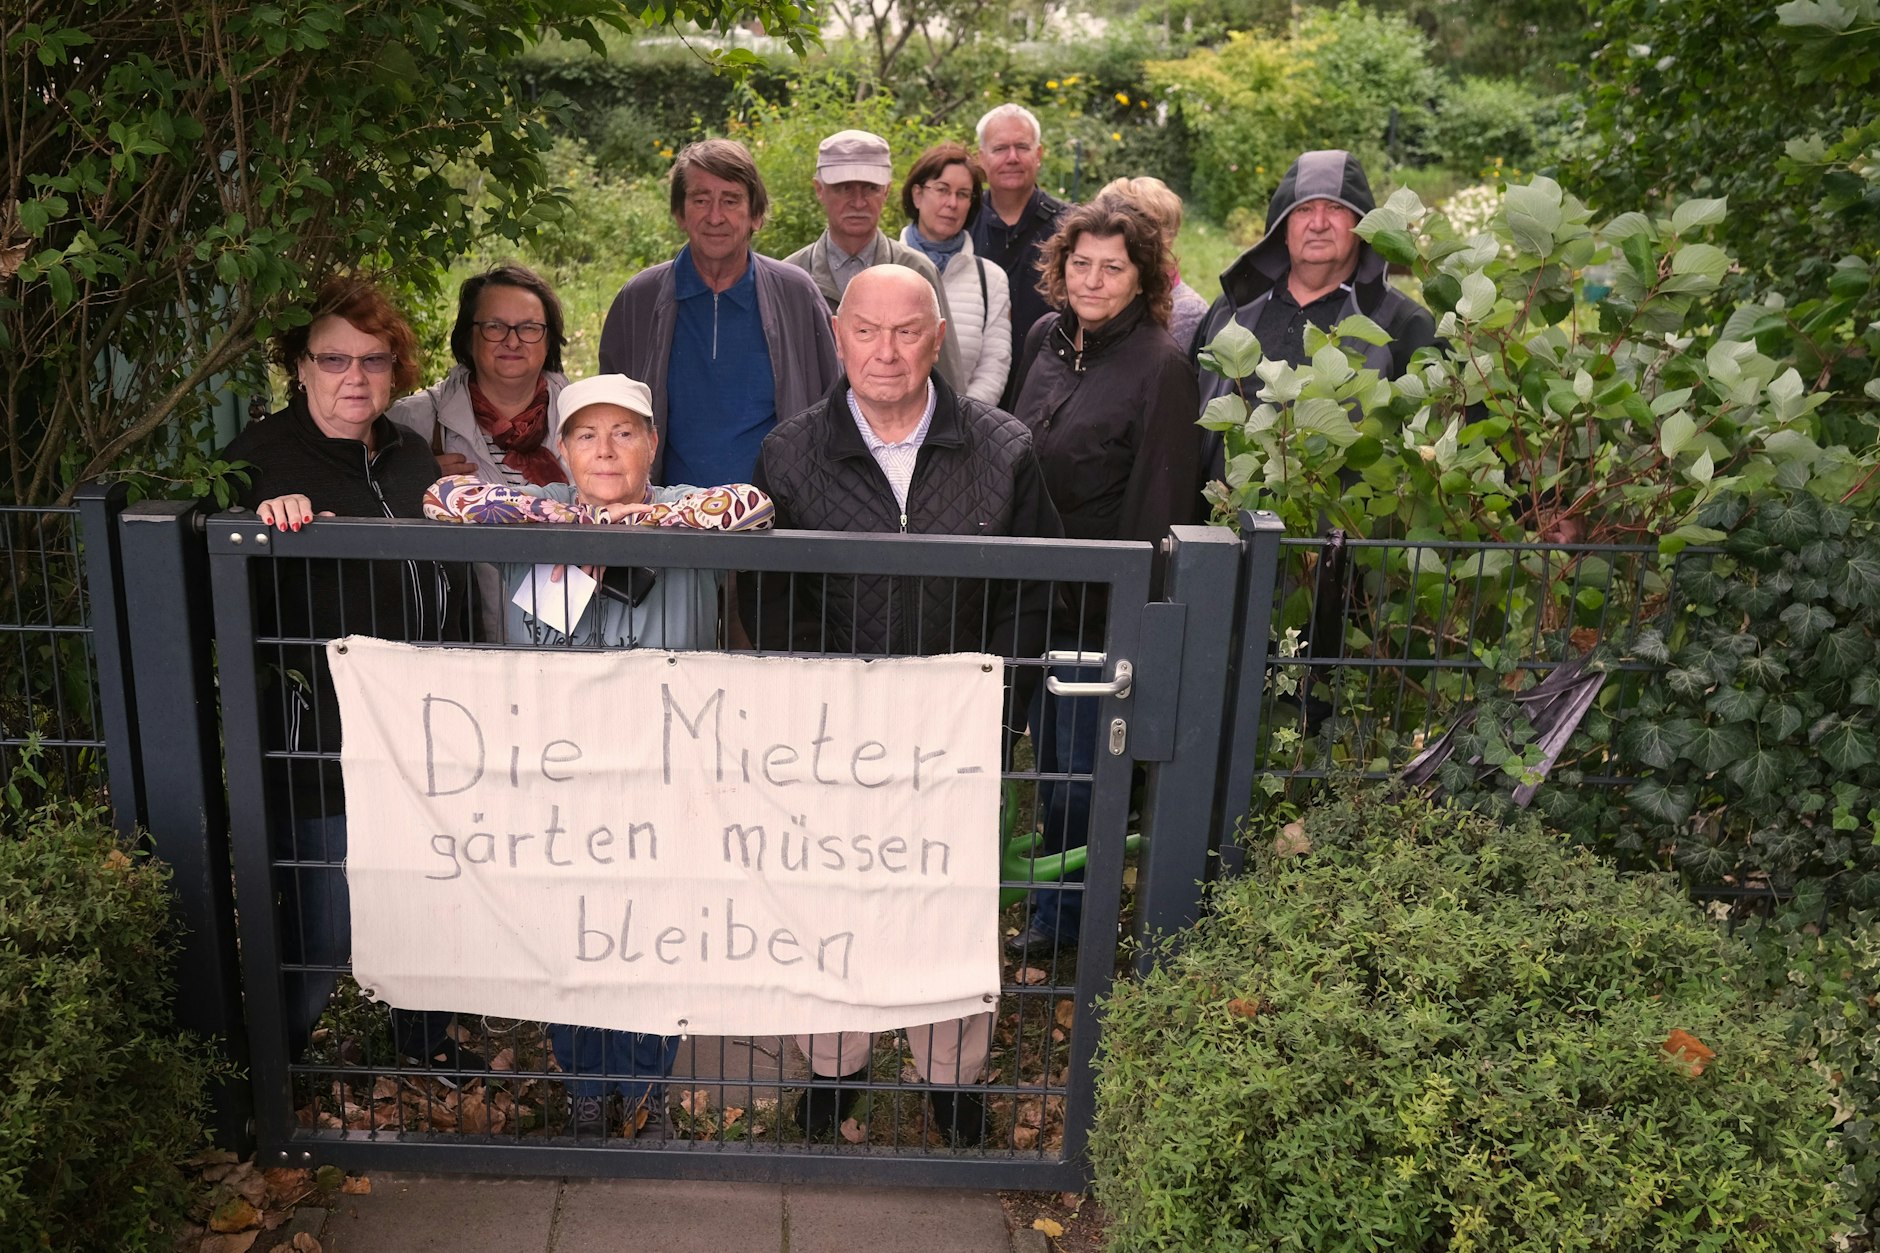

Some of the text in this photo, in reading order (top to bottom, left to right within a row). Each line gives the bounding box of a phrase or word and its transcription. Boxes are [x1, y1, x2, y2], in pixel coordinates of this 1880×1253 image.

[422, 683, 984, 798] Die Mieter-
[424, 805, 951, 881] gärten müssen
[576, 894, 856, 979] bleiben
